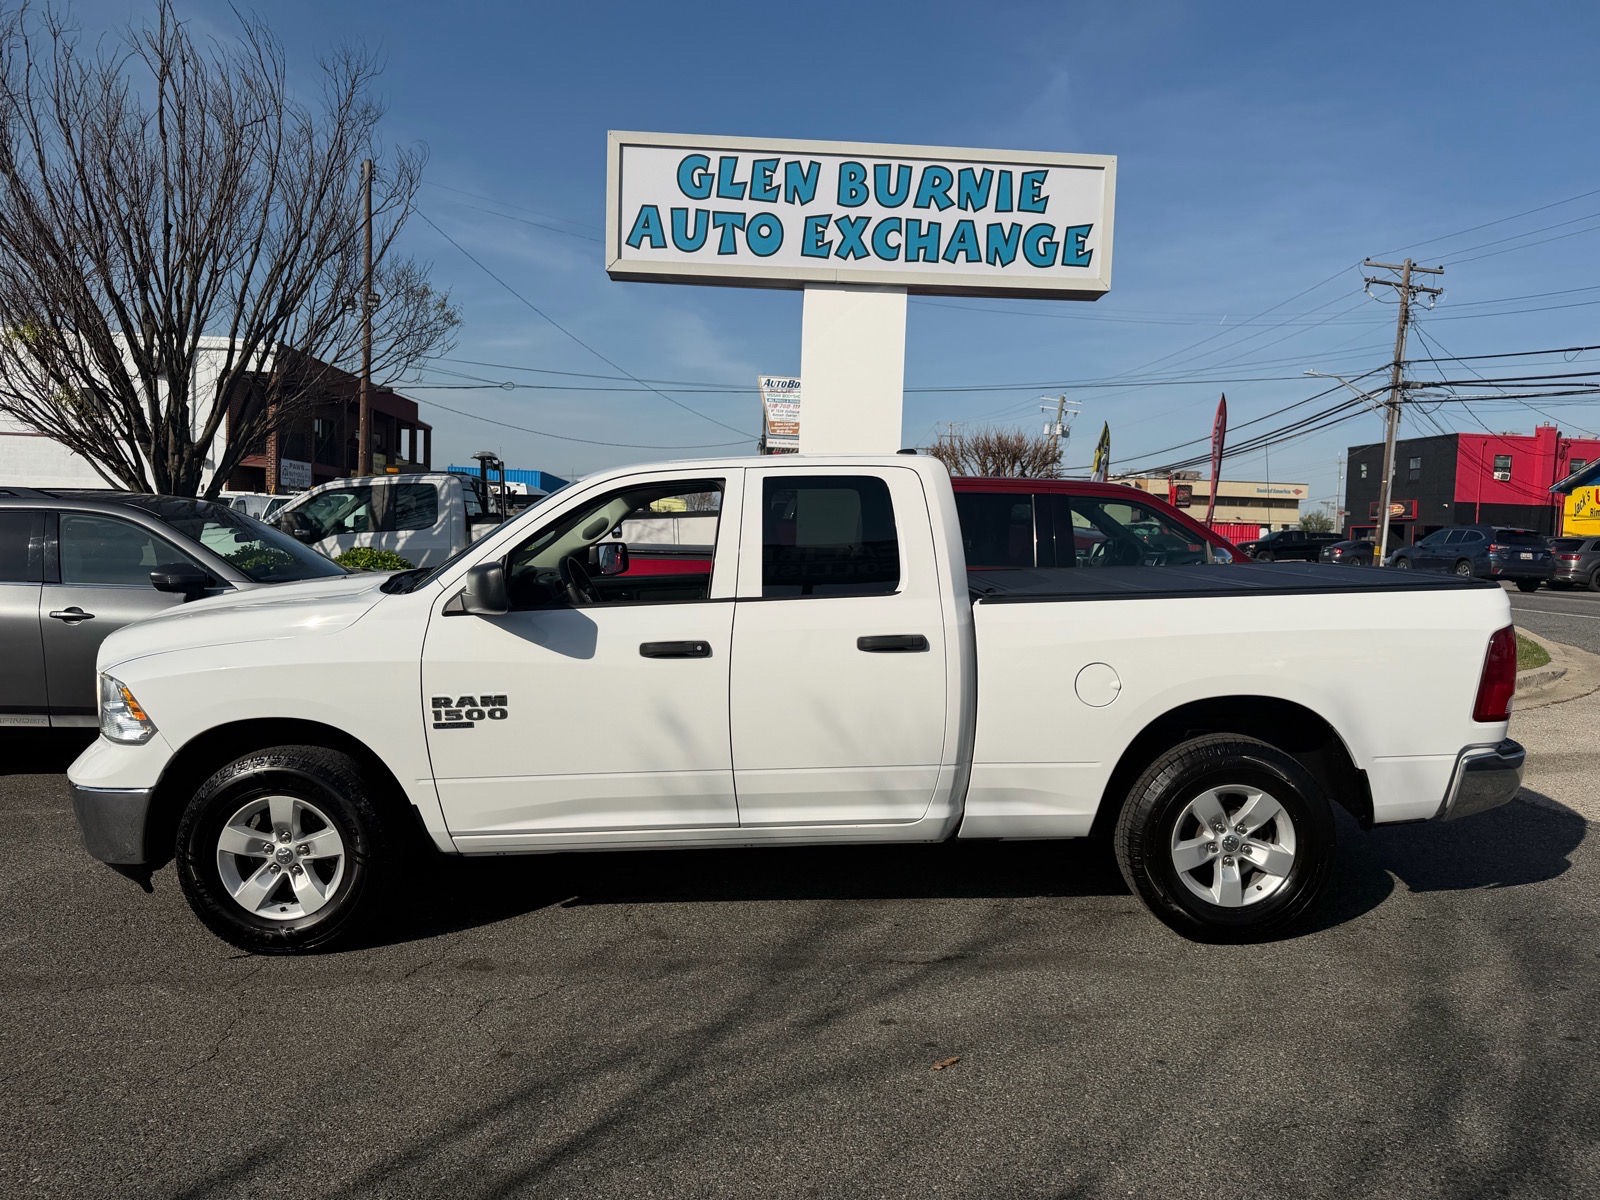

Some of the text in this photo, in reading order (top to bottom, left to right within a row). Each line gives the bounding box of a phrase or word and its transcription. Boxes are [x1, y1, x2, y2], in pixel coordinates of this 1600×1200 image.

[677, 153, 1049, 214] GLEN BURNIE
[625, 204, 1094, 268] AUTO EXCHANGE
[289, 463, 305, 471] PAWN
[1573, 490, 1590, 517] Jack's
[431, 694, 508, 708] RAM
[432, 708, 508, 721] 1500
